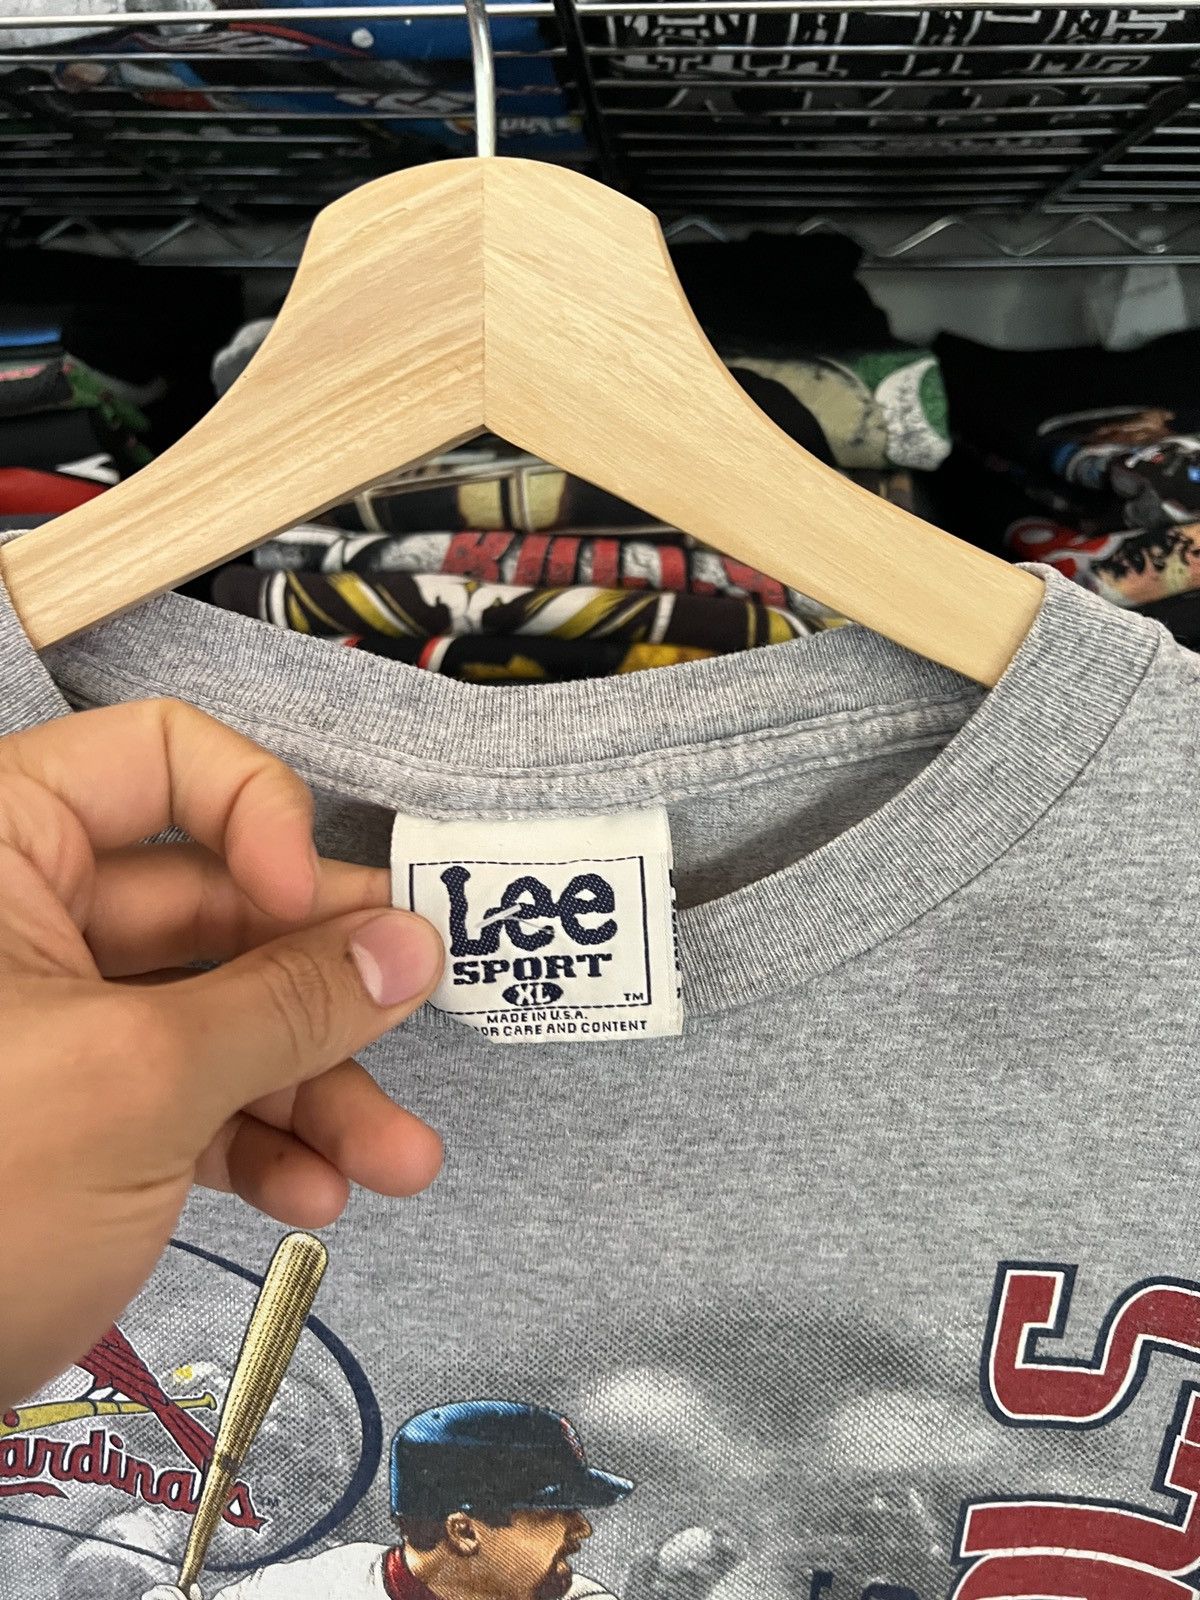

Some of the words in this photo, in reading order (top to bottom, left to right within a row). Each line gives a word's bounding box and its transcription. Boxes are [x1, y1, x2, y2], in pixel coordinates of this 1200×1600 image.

[440, 866, 618, 957] Lee
[453, 953, 613, 985] SPORT
[513, 983, 553, 1006] XL
[623, 992, 644, 1001] TM
[487, 1012, 528, 1024] MADE
[532, 1011, 547, 1022] IN
[550, 1010, 589, 1021] U.S.A.
[474, 1026, 499, 1036] OR
[503, 1025, 542, 1036] CARE
[546, 1022, 577, 1034] AND
[581, 1020, 648, 1033] CONTENT
